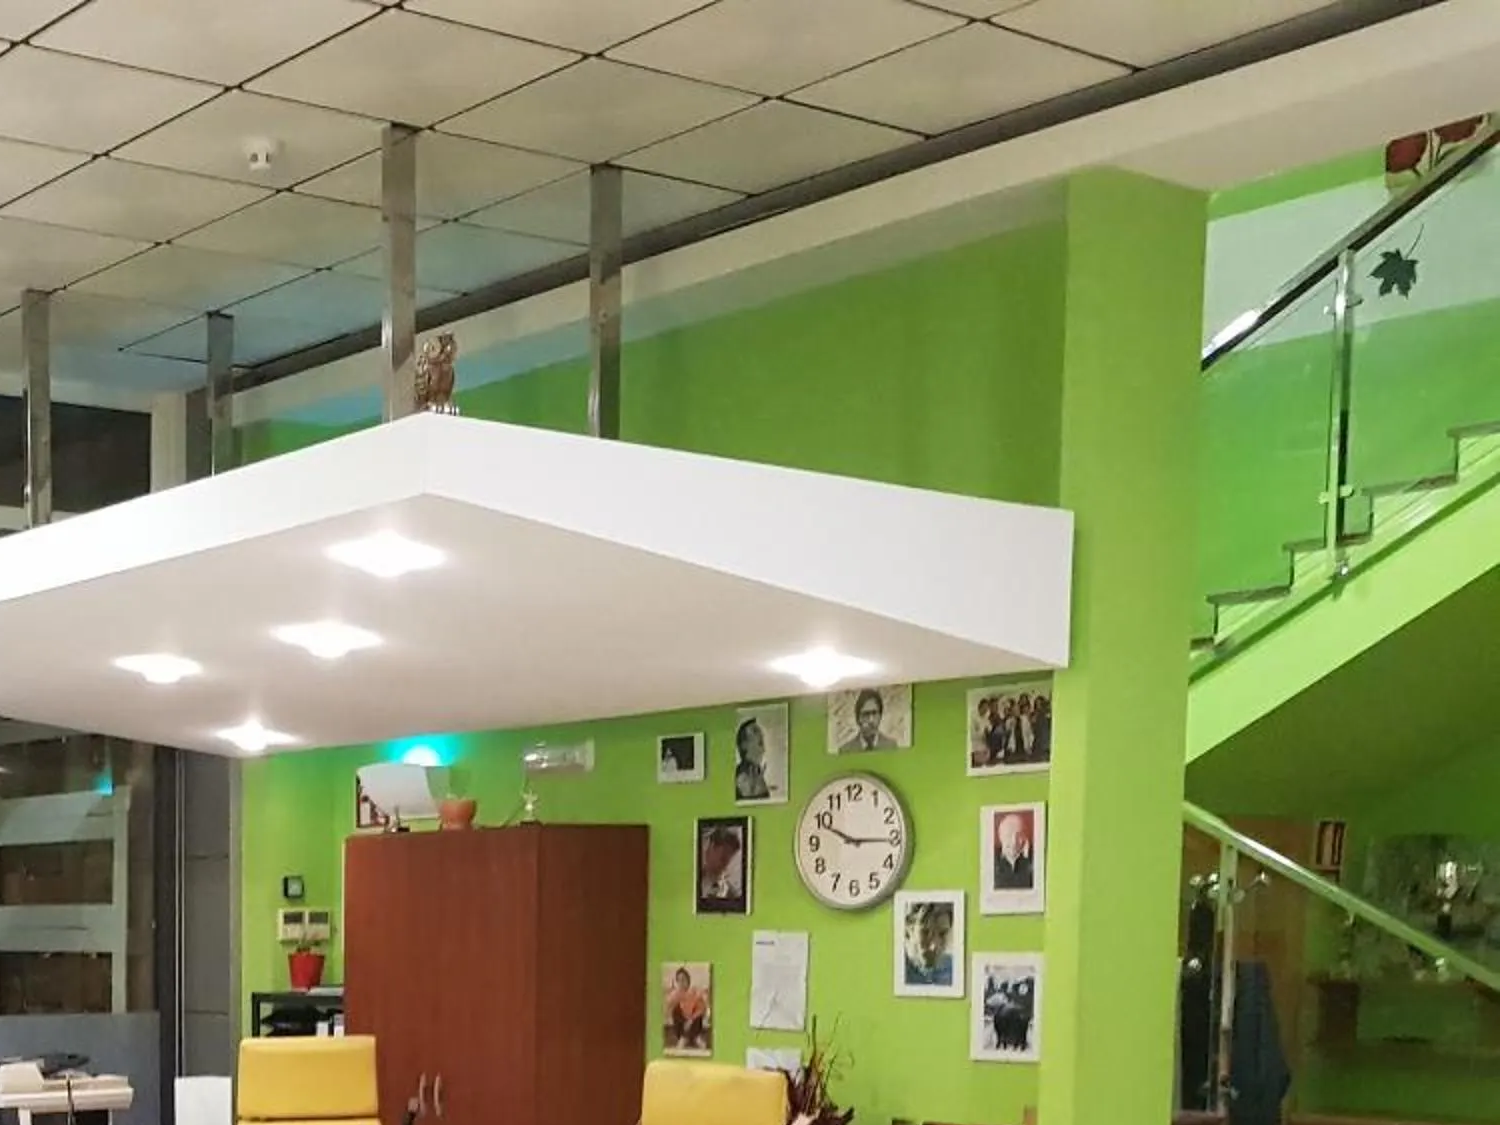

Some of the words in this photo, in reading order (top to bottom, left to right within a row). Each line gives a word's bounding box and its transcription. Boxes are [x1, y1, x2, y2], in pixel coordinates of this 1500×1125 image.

[828, 793, 842, 811] 11
[844, 783, 863, 802] 12
[871, 789, 879, 808] 1
[814, 811, 833, 829] 10
[883, 807, 895, 825] 2
[808, 834, 821, 853] 9
[889, 828, 901, 848] 3
[814, 856, 826, 875] 8
[882, 853, 894, 871] 4
[831, 872, 841, 893] 7
[849, 879, 860, 897] 6
[868, 871, 880, 890] 5
